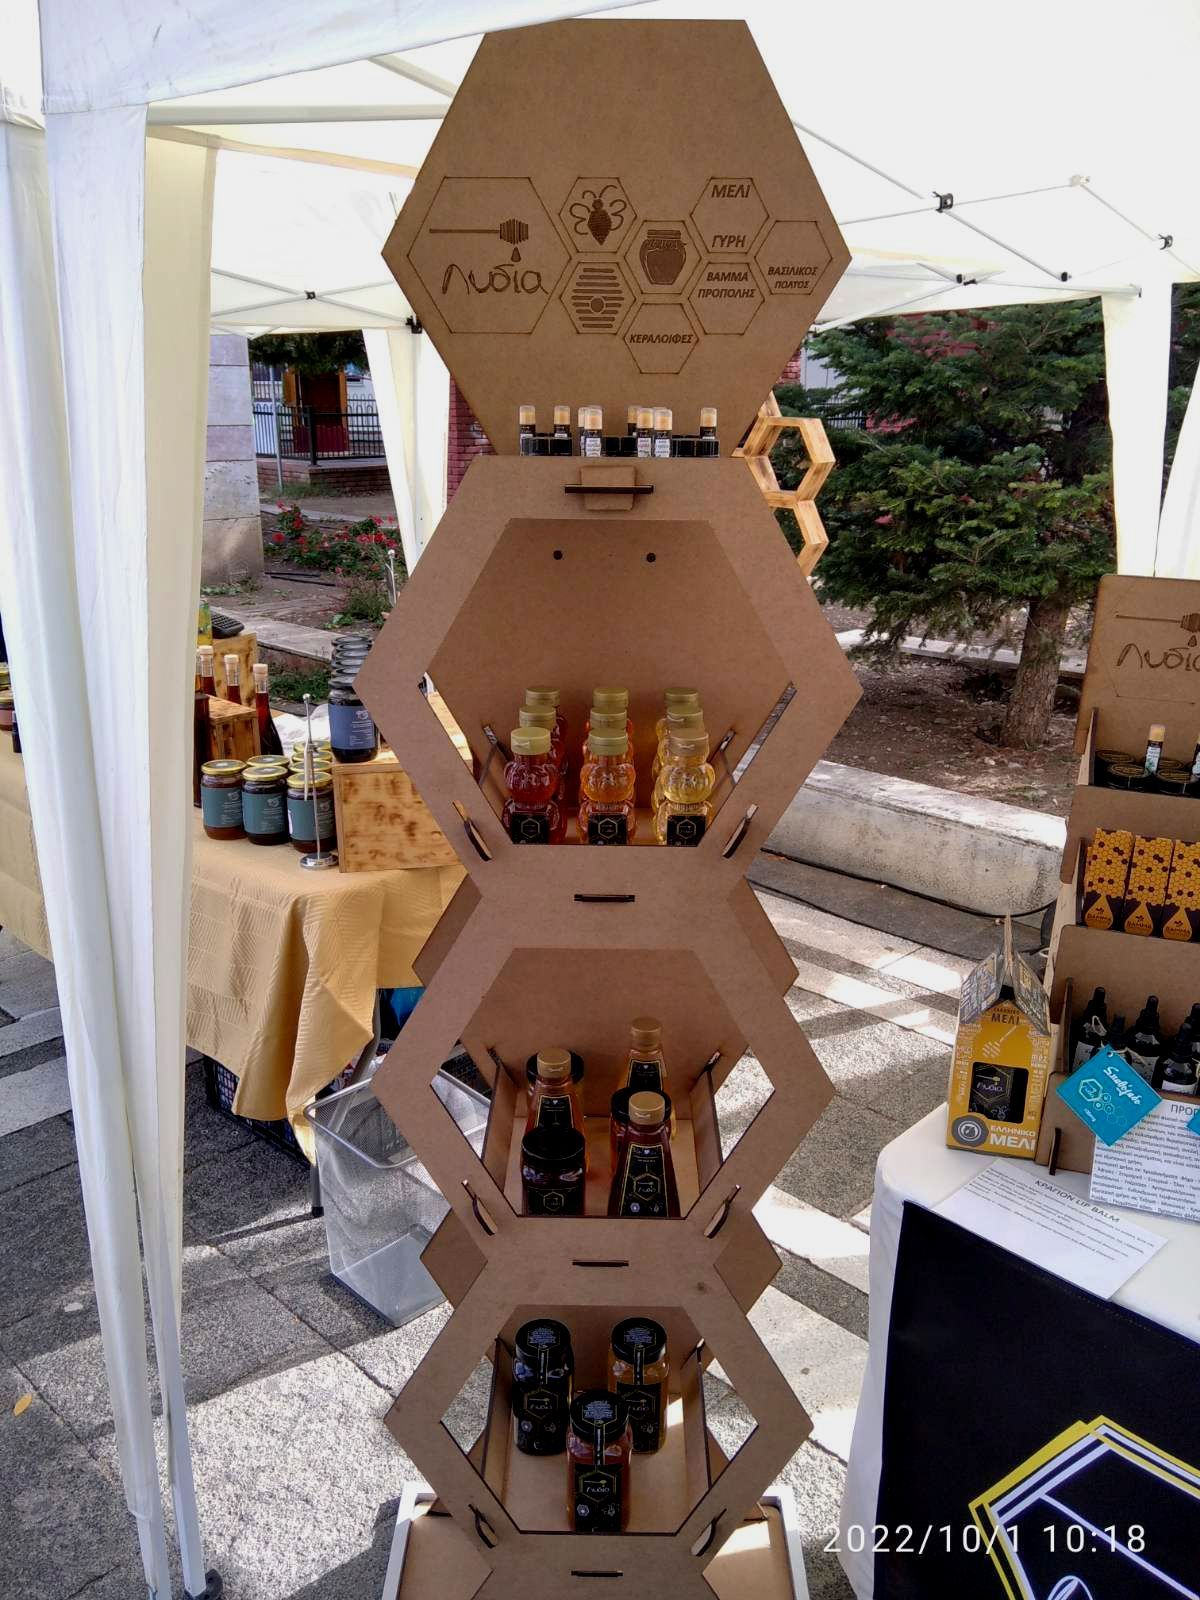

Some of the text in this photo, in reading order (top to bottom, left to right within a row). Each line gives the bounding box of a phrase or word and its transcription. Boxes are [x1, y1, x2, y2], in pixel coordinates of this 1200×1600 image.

[711, 184, 751, 198] ΜΕΛΙ
[711, 235, 747, 248] ΓΥΡΗ
[706, 272, 749, 282] ΒΑΜΜΑ
[767, 266, 818, 276] ΒΑΣΙΛΙΚΟΣ
[774, 281, 810, 289] ΠΟΛΤΟΣ
[697, 289, 757, 298] ΠΡΟΠΟΛΗΣ
[629, 334, 694, 344] ΚΕΡΑΛΟΙΦΕΣ
[991, 1012, 1020, 1025] ΜΕΛΙ
[990, 1125, 1036, 1137] ΕΛΛΗΝΙΚΟ
[990, 1133, 1036, 1152] ΜΕΛΙ
[1034, 1180, 1075, 1202] ΚΡΑΓΙΟΝ
[1091, 1206, 1121, 1223] BALM
